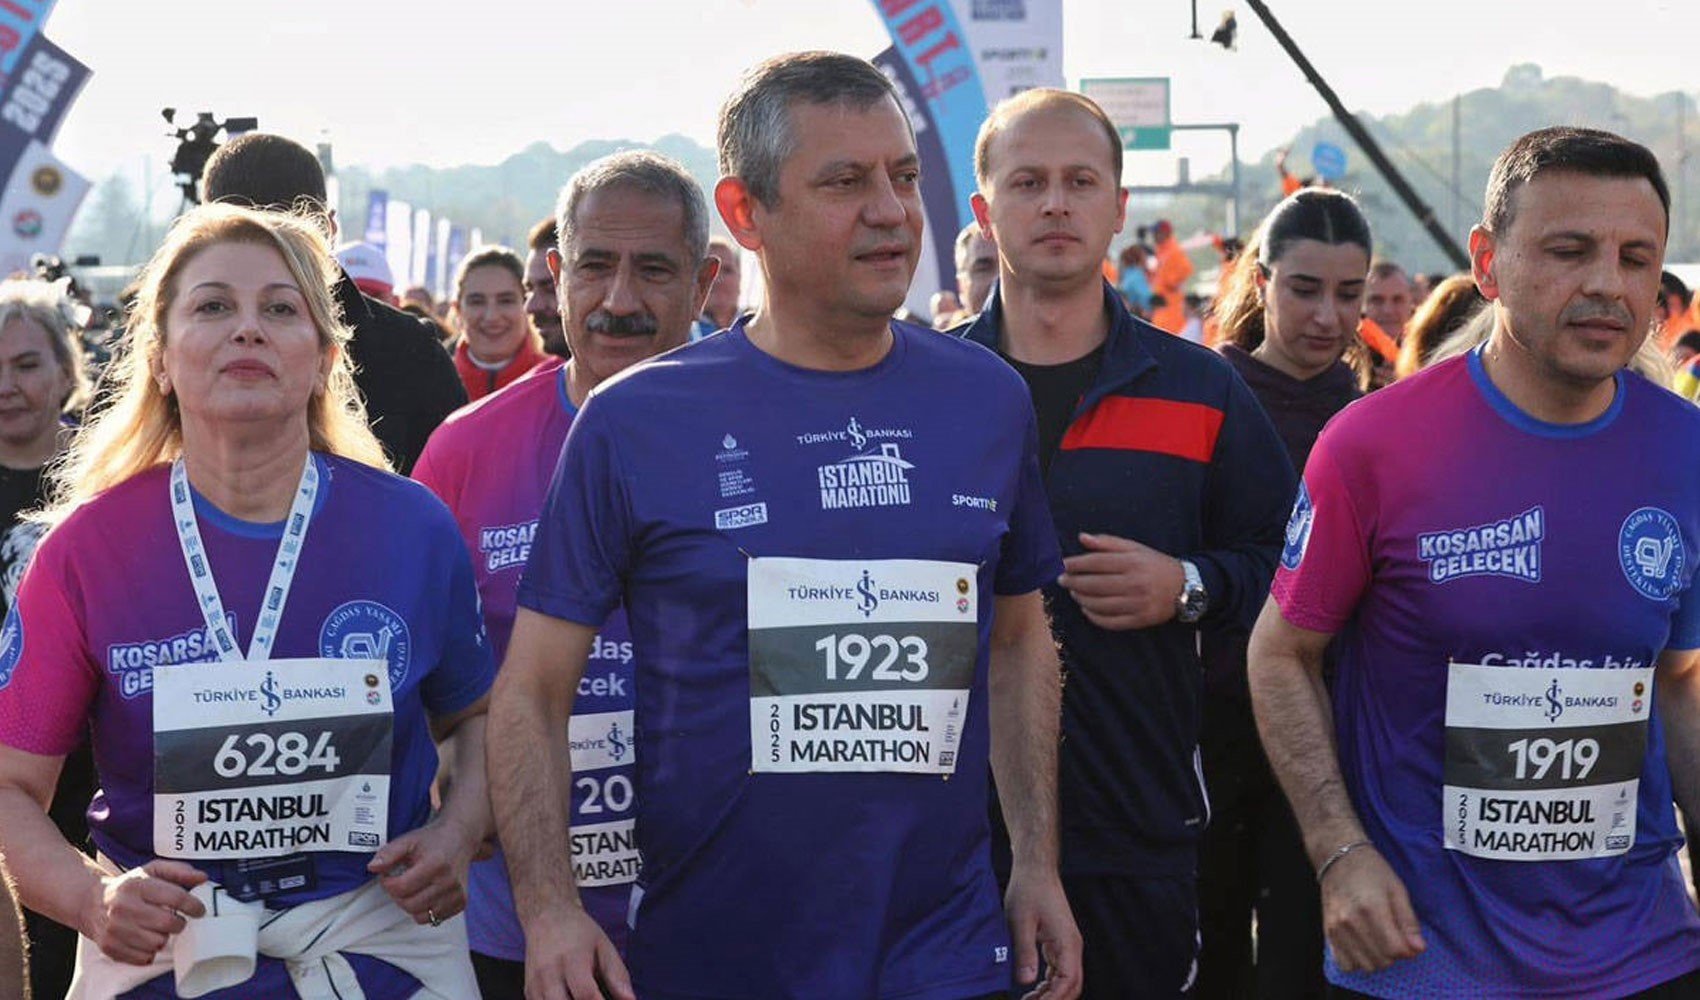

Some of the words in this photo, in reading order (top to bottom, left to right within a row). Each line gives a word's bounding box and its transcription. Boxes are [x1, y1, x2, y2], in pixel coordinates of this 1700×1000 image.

[2, 51, 70, 133] 2025
[797, 430, 848, 445] TÜRKİYE
[821, 483, 911, 510] MARATONU
[1421, 509, 1540, 558] KOŞARSAN
[1432, 545, 1538, 581] GELECEK!
[788, 585, 854, 600] TÜRKİYE
[880, 589, 940, 602] BANKASI
[111, 606, 234, 670] KOŞARSA
[815, 633, 930, 682] 1923
[193, 688, 257, 703] TÜRKİYE
[283, 687, 346, 700] BANKASI
[1483, 693, 1543, 707] TÜRKİYE
[1565, 696, 1618, 708] BANKASI
[770, 703, 780, 763] 2025
[793, 703, 929, 731] ISTANBUL
[213, 731, 341, 778] 6284
[790, 739, 930, 763] MARATHON
[1507, 738, 1600, 780] 1919
[198, 793, 329, 825] ISTANBUL
[575, 774, 634, 815] 20
[1478, 797, 1595, 825] ISTANBUL
[175, 800, 185, 851] 2025
[1459, 793, 1468, 845] 2025
[194, 823, 330, 852] MARATHON
[1473, 828, 1595, 853] MARATHON
